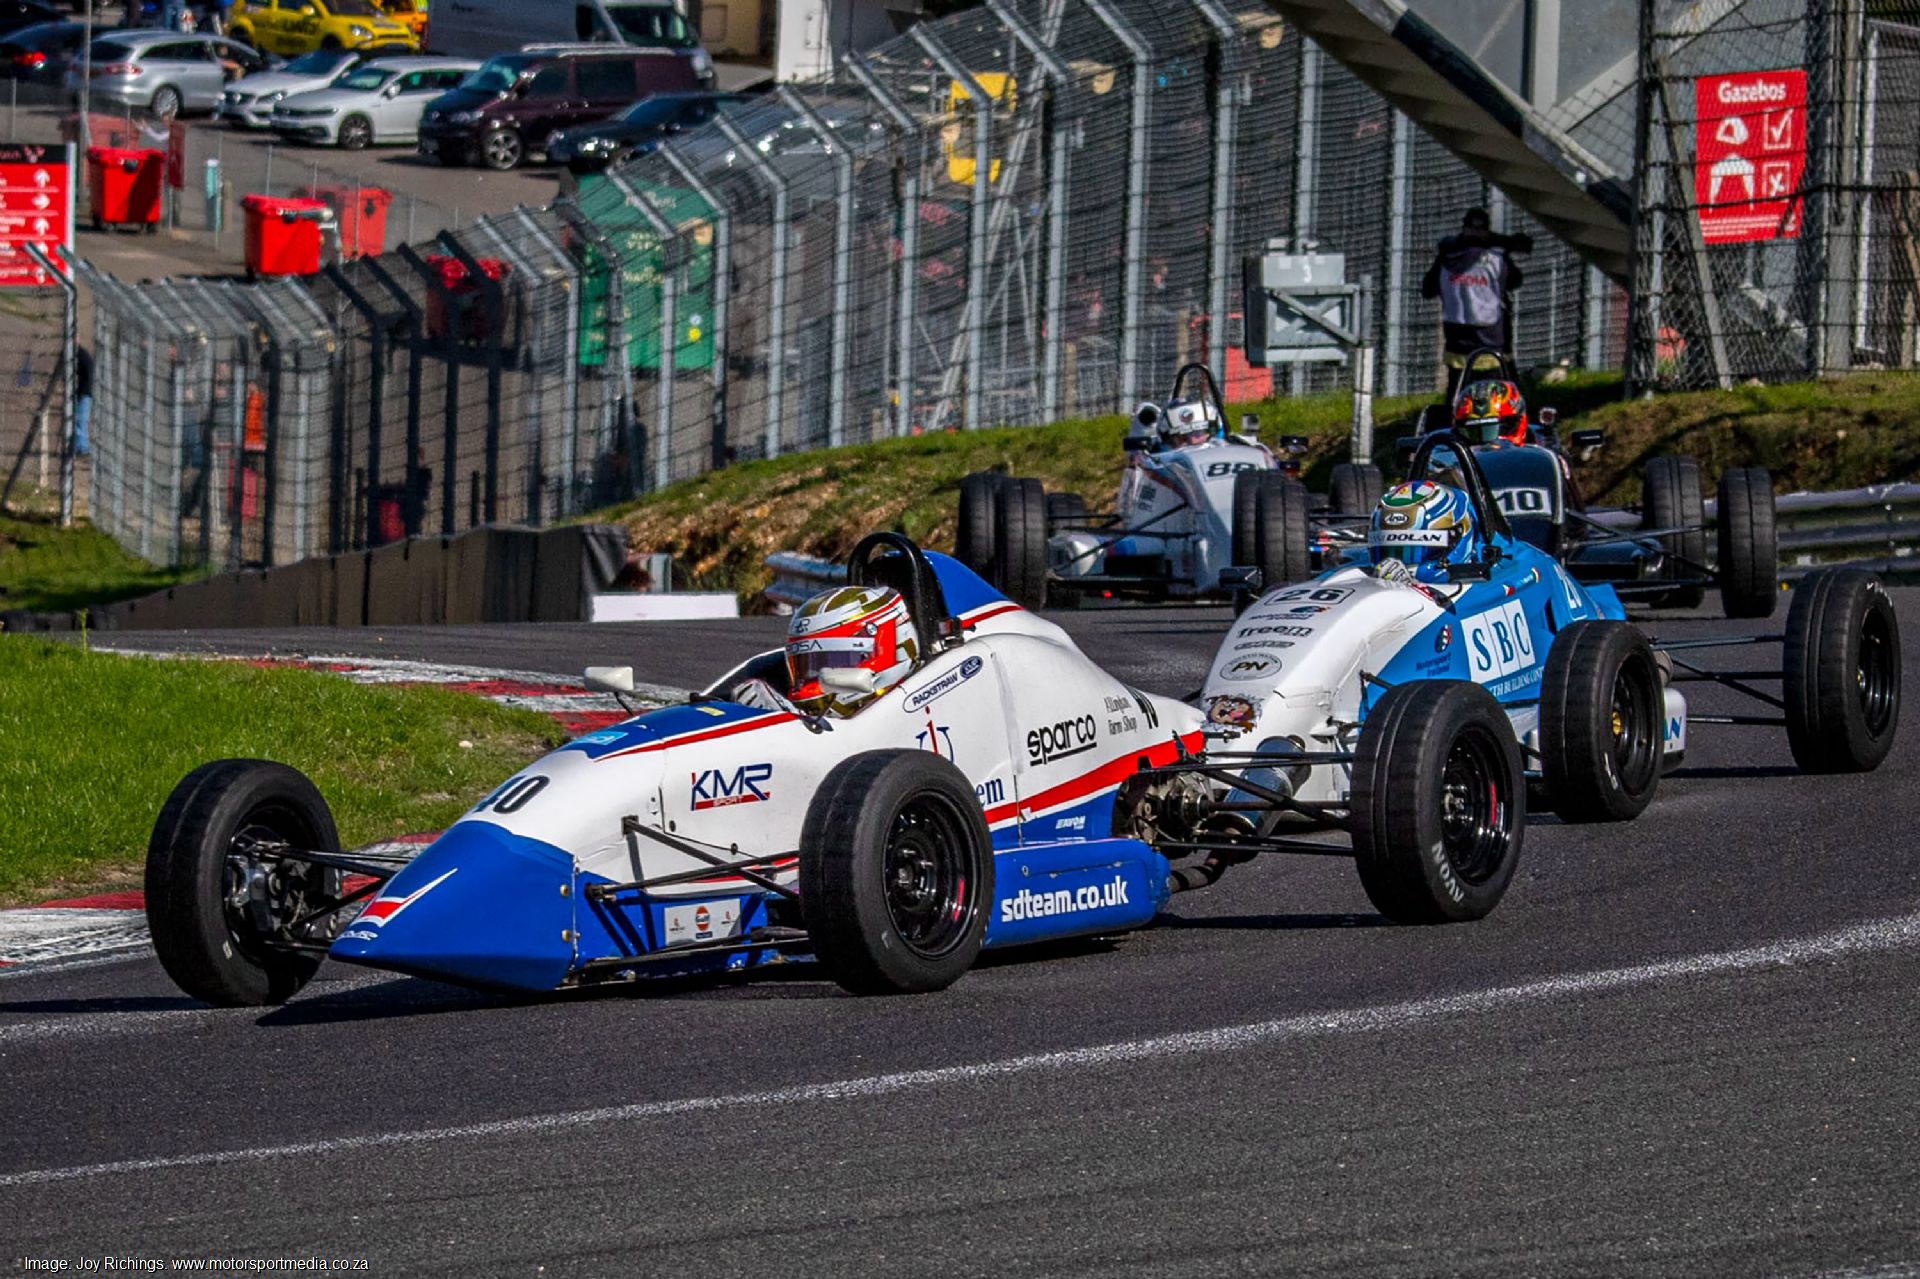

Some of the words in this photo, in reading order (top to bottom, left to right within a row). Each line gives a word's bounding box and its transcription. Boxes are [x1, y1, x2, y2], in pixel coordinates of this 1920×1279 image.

[1718, 80, 1786, 102] Gazebos
[1304, 265, 1312, 282] 3
[1386, 533, 1441, 542] DOLAN
[1274, 588, 1344, 602] 26
[1231, 660, 1270, 673] PN
[912, 671, 958, 706] RACKSTRAW
[1027, 714, 1096, 764] sparco
[690, 763, 772, 811] KMR
[1001, 875, 1129, 922] sdteam.co.uk
